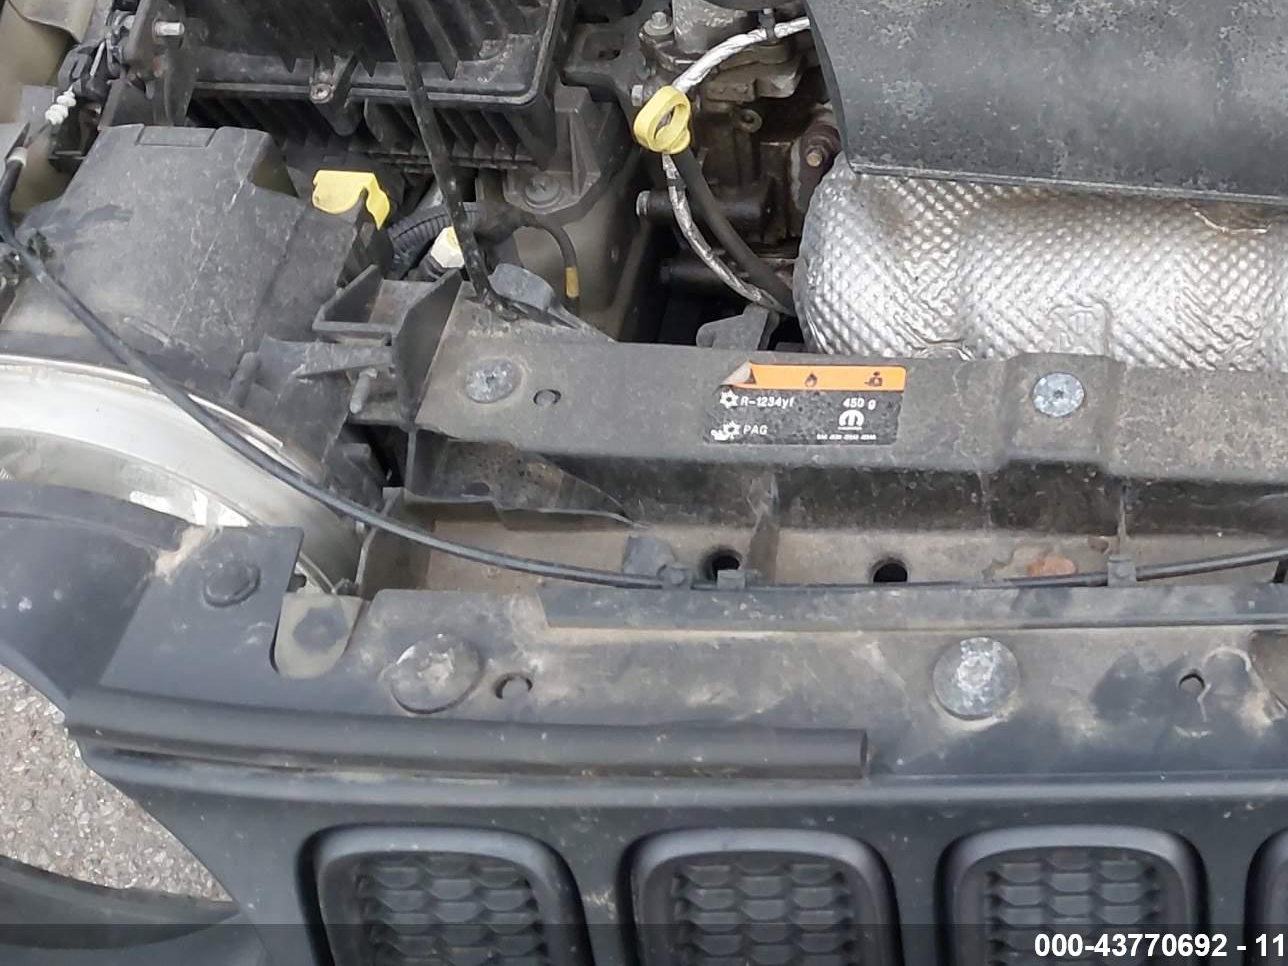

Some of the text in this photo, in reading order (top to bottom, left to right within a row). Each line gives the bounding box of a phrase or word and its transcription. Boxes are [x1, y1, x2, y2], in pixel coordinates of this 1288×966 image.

[741, 395, 794, 409] R-1234yf
[843, 397, 865, 408] 450
[743, 424, 768, 435] PAG
